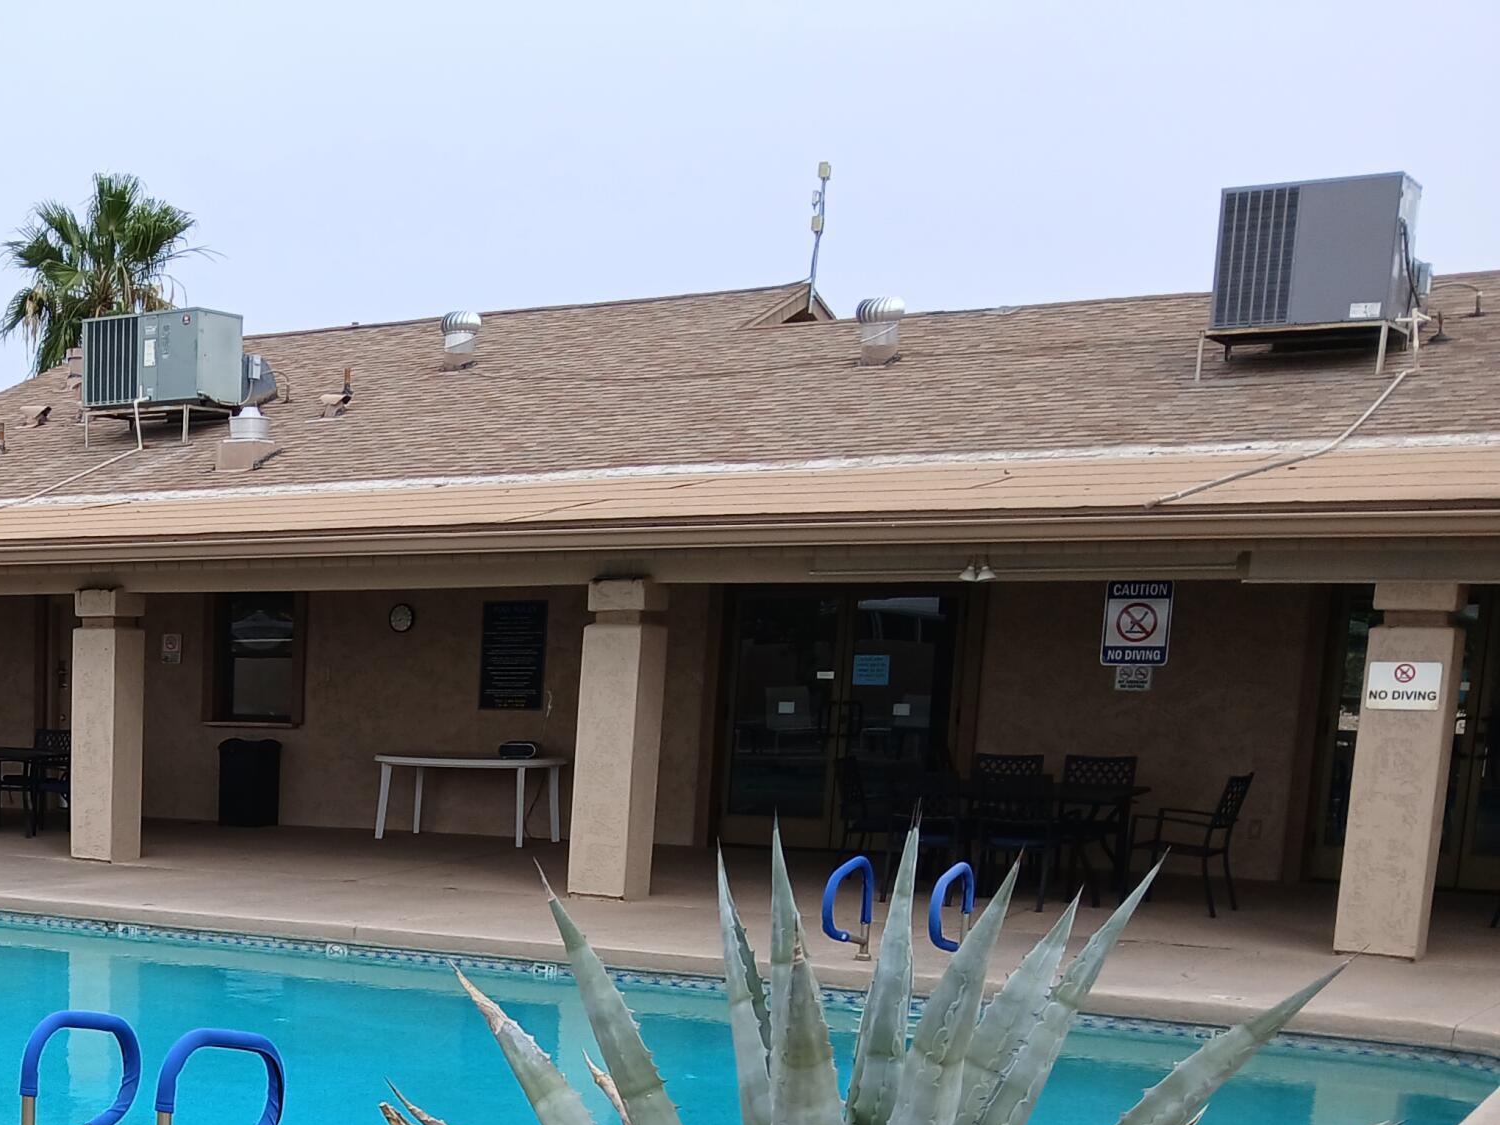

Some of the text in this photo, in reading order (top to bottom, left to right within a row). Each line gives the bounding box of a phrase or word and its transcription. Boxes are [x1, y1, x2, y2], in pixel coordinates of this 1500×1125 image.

[1113, 583, 1168, 596] CAUTION
[1106, 649, 1161, 661] NO DIVING
[1368, 690, 1437, 701] NO DIVING
